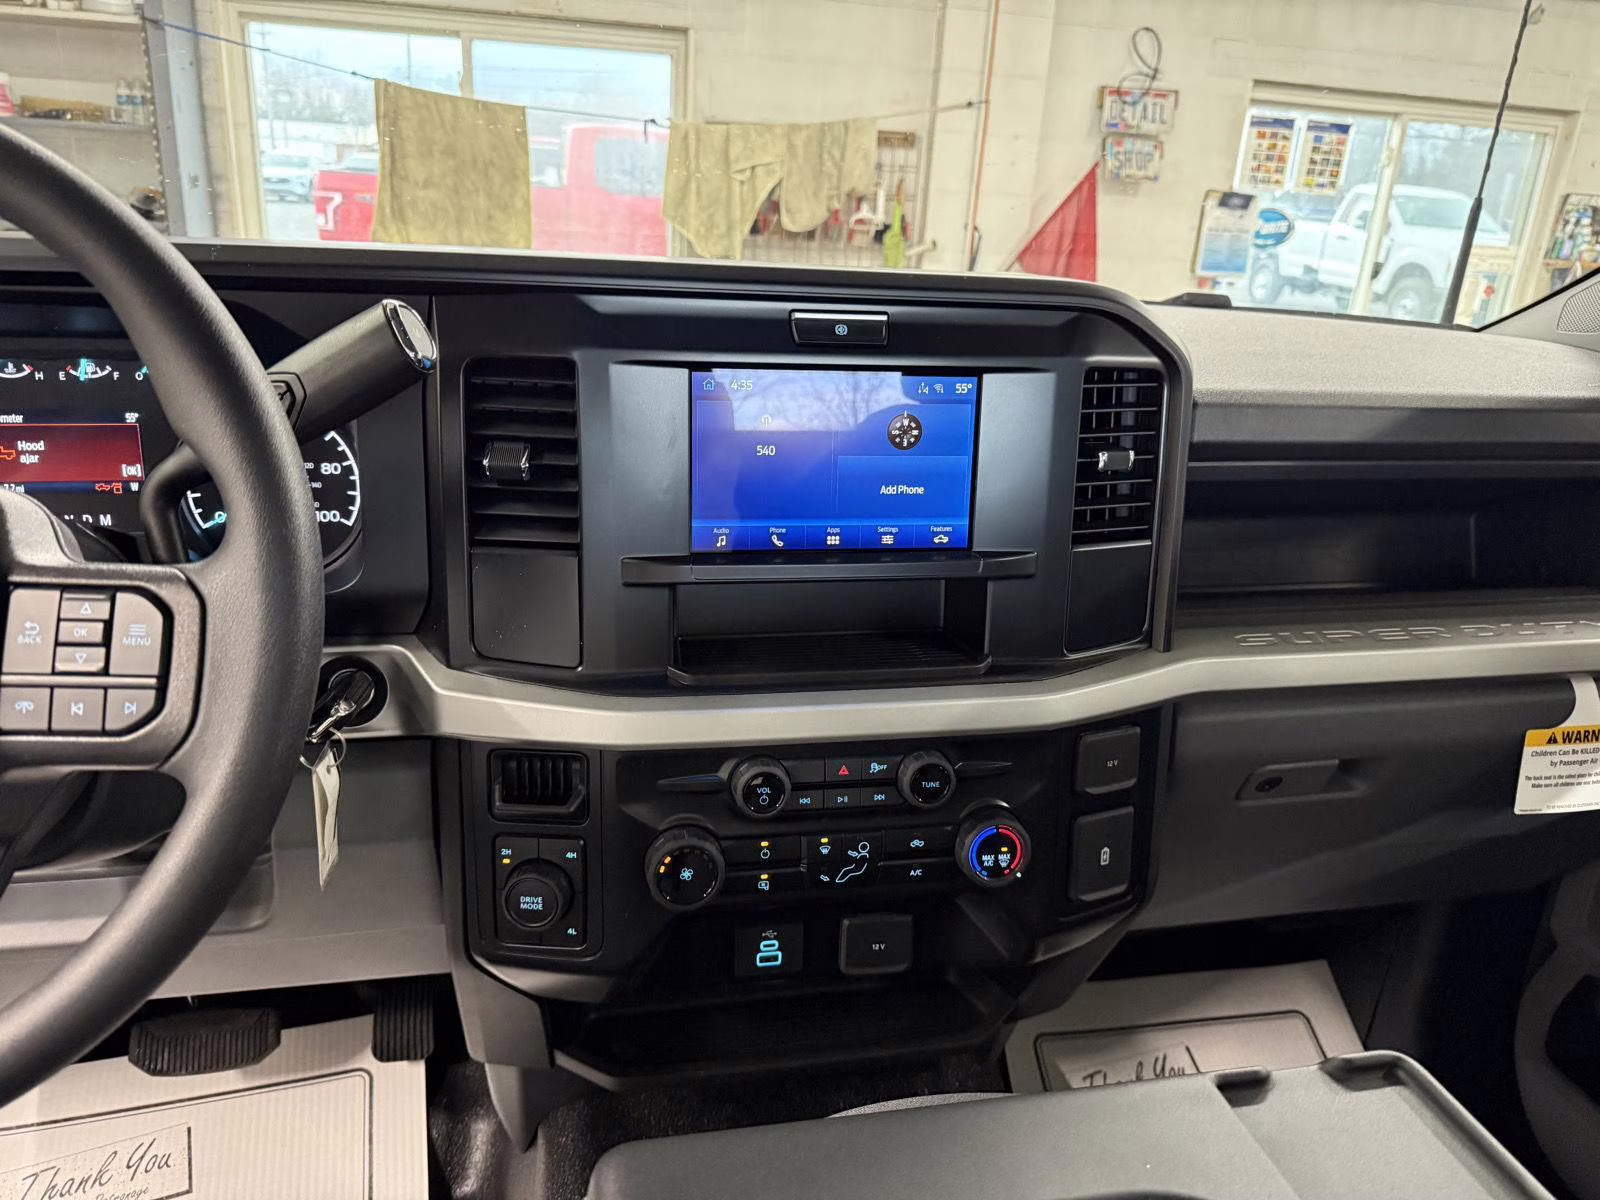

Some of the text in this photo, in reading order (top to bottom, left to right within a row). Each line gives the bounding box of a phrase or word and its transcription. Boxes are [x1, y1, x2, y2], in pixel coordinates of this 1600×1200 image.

[1109, 100, 1168, 124] DETAIL
[1113, 150, 1155, 172] SHOP
[35, 371, 44, 380] H
[59, 371, 66, 380] E
[113, 371, 120, 380] F
[731, 379, 753, 390] 4:35
[0, 413, 23, 423] meter
[17, 440, 45, 451] Hood
[756, 445, 776, 456] 540
[20, 453, 39, 464] ajar
[320, 462, 341, 475] 80
[130, 482, 139, 491] W
[880, 484, 925, 495] Add Phone
[100, 513, 112, 526] M
[315, 510, 341, 522] 100
[712, 526, 730, 534] Audio
[769, 526, 787, 534] Phone
[826, 526, 841, 534] Apps
[877, 525, 899, 534] Settings
[930, 525, 953, 533] Features
[73, 628, 88, 638] OK
[1234, 624, 1453, 647] SUPER
[16, 635, 42, 645] BACK
[122, 636, 151, 647] MENU
[1561, 729, 1600, 744] WARN
[1530, 750, 1557, 758] Children
[1580, 747, 1600, 755] KILLED
[1549, 760, 1558, 768] by
[1559, 759, 1589, 767] Passenger
[910, 868, 922, 876] A/C
[20, 1137, 171, 1200] Thank You
[96, 1187, 149, 1200] Ptronage
